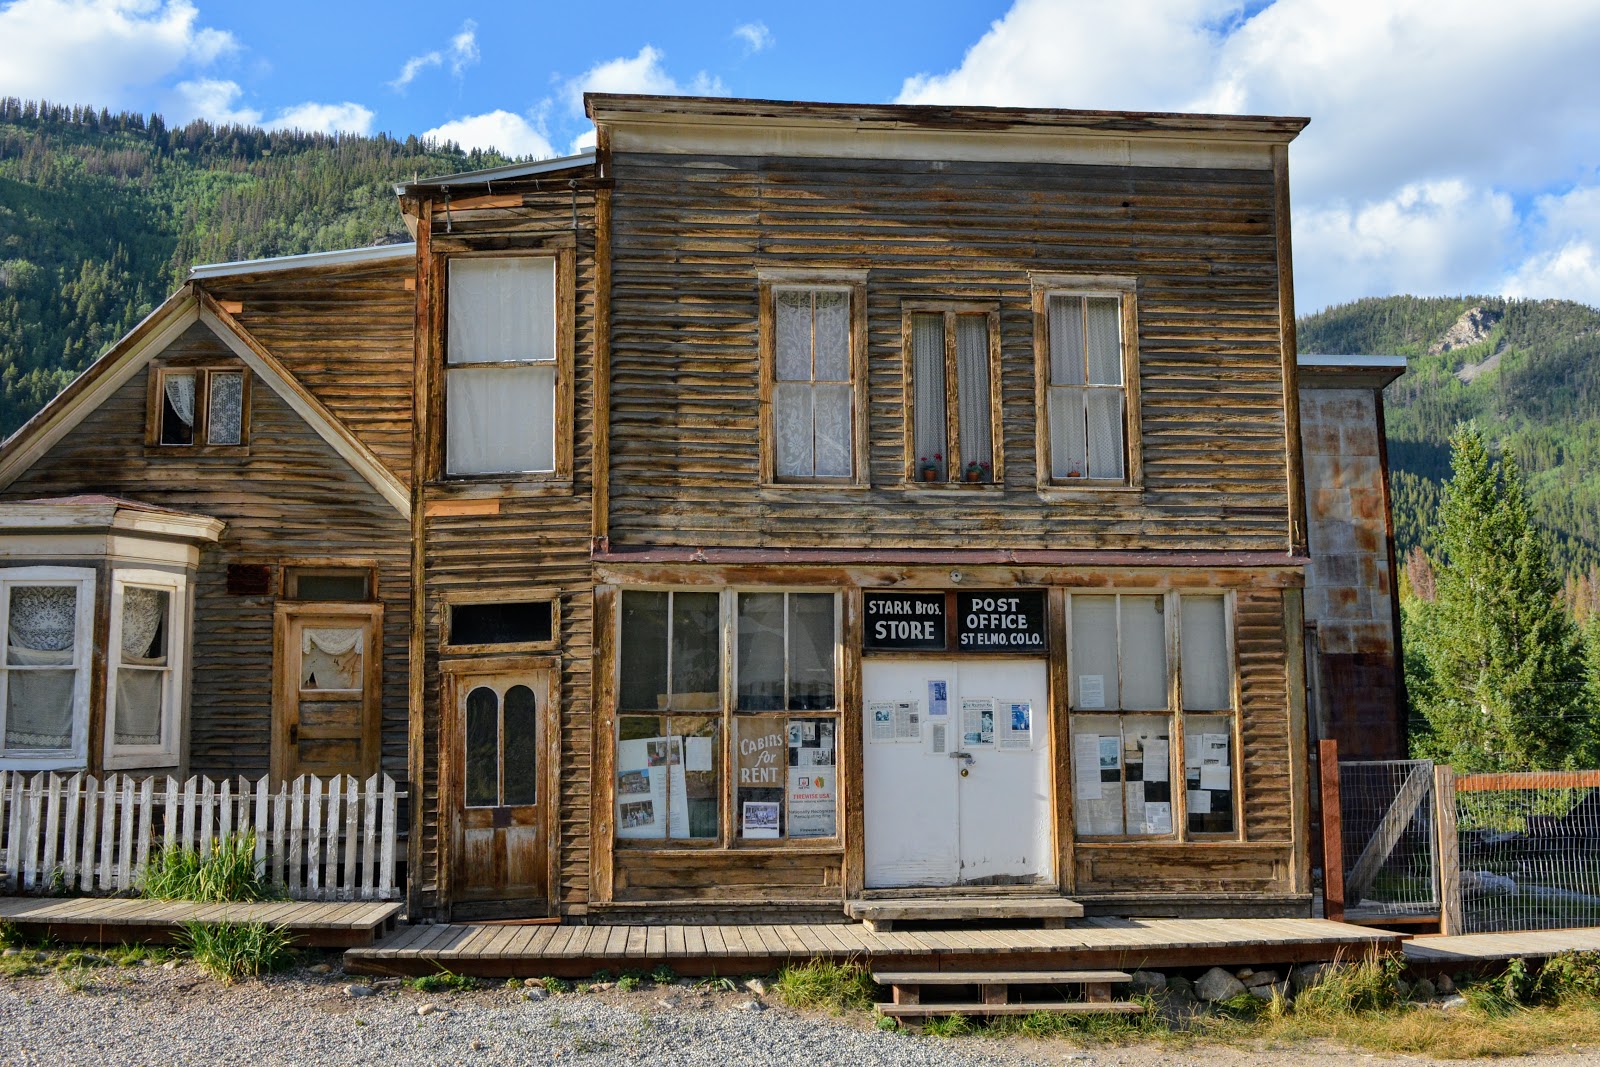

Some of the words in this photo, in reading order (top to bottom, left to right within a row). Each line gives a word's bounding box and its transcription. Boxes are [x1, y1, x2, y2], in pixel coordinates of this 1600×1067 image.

[868, 600, 912, 615] STARK
[915, 602, 942, 616] Bros.
[971, 598, 1020, 612] POST
[966, 614, 1028, 629] OFFICE
[875, 620, 935, 640] STORE
[960, 632, 975, 645] ST
[977, 632, 1008, 646] ELMO,
[1009, 632, 1043, 645] COLO.
[754, 750, 777, 767] for
[740, 767, 778, 783] RENT
